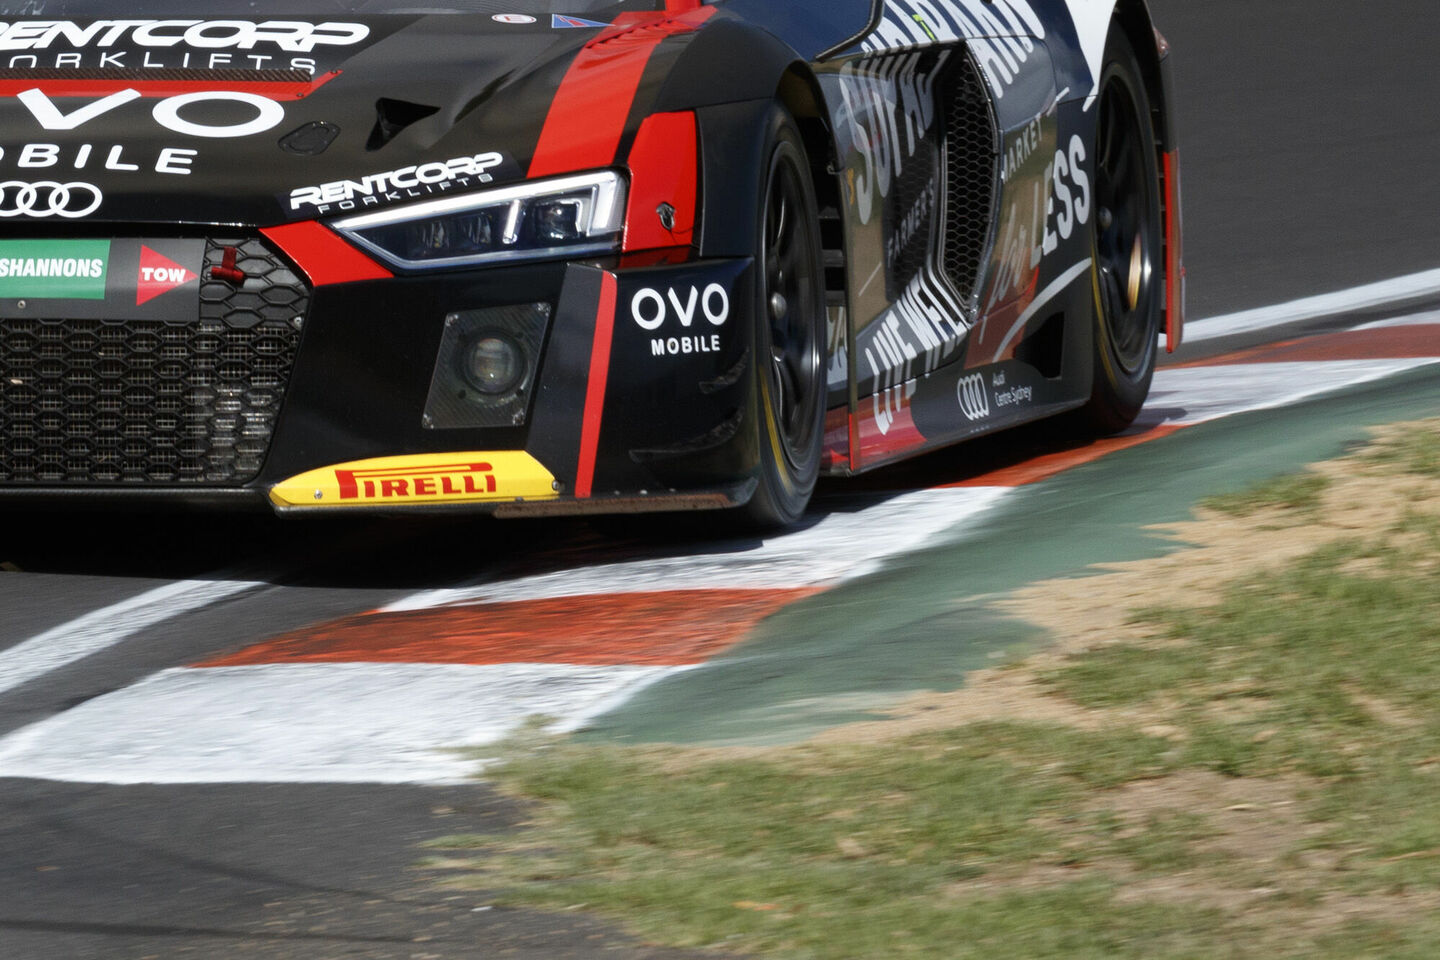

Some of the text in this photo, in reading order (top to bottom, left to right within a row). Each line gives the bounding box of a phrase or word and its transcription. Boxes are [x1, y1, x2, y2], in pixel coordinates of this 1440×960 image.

[290, 151, 503, 210] RENTCORP
[318, 172, 494, 215] FORKLIFTS
[1028, 134, 1091, 270] LESS
[141, 266, 186, 283] TOW
[631, 283, 729, 330] OVO
[651, 334, 721, 356] MOBILE
[334, 462, 497, 500] PIRELLI
